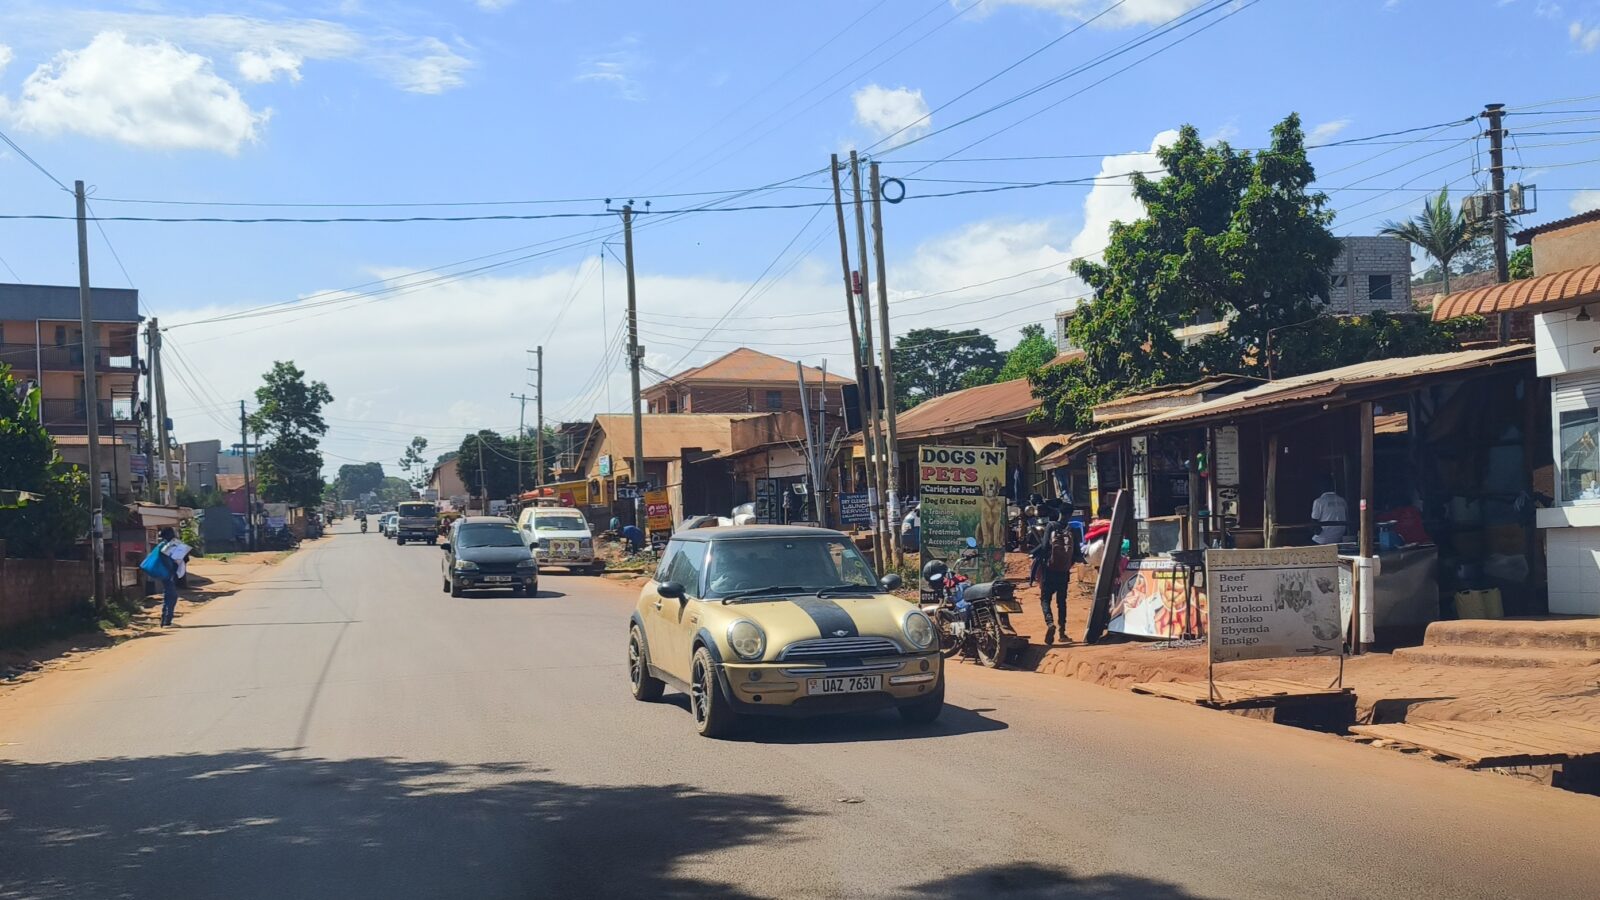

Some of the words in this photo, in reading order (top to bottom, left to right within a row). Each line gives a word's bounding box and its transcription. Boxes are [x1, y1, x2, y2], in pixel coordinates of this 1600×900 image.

[921, 449, 976, 465] DOGS
[921, 466, 978, 483] PETS
[924, 497, 938, 505] Dog
[929, 508, 955, 517] Training
[928, 518, 959, 527] Grooming
[929, 528, 961, 536] Treatment
[1219, 573, 1246, 582] Beef
[1220, 584, 1249, 593] Liver
[1220, 594, 1263, 603] Embuzi
[1220, 603, 1274, 614] Molokoni
[1221, 614, 1264, 625] Enkoko
[1221, 625, 1270, 636] Ebyenda
[1221, 636, 1260, 646] Ensigo
[822, 679, 845, 692] UAZ
[849, 677, 876, 690] 763V
